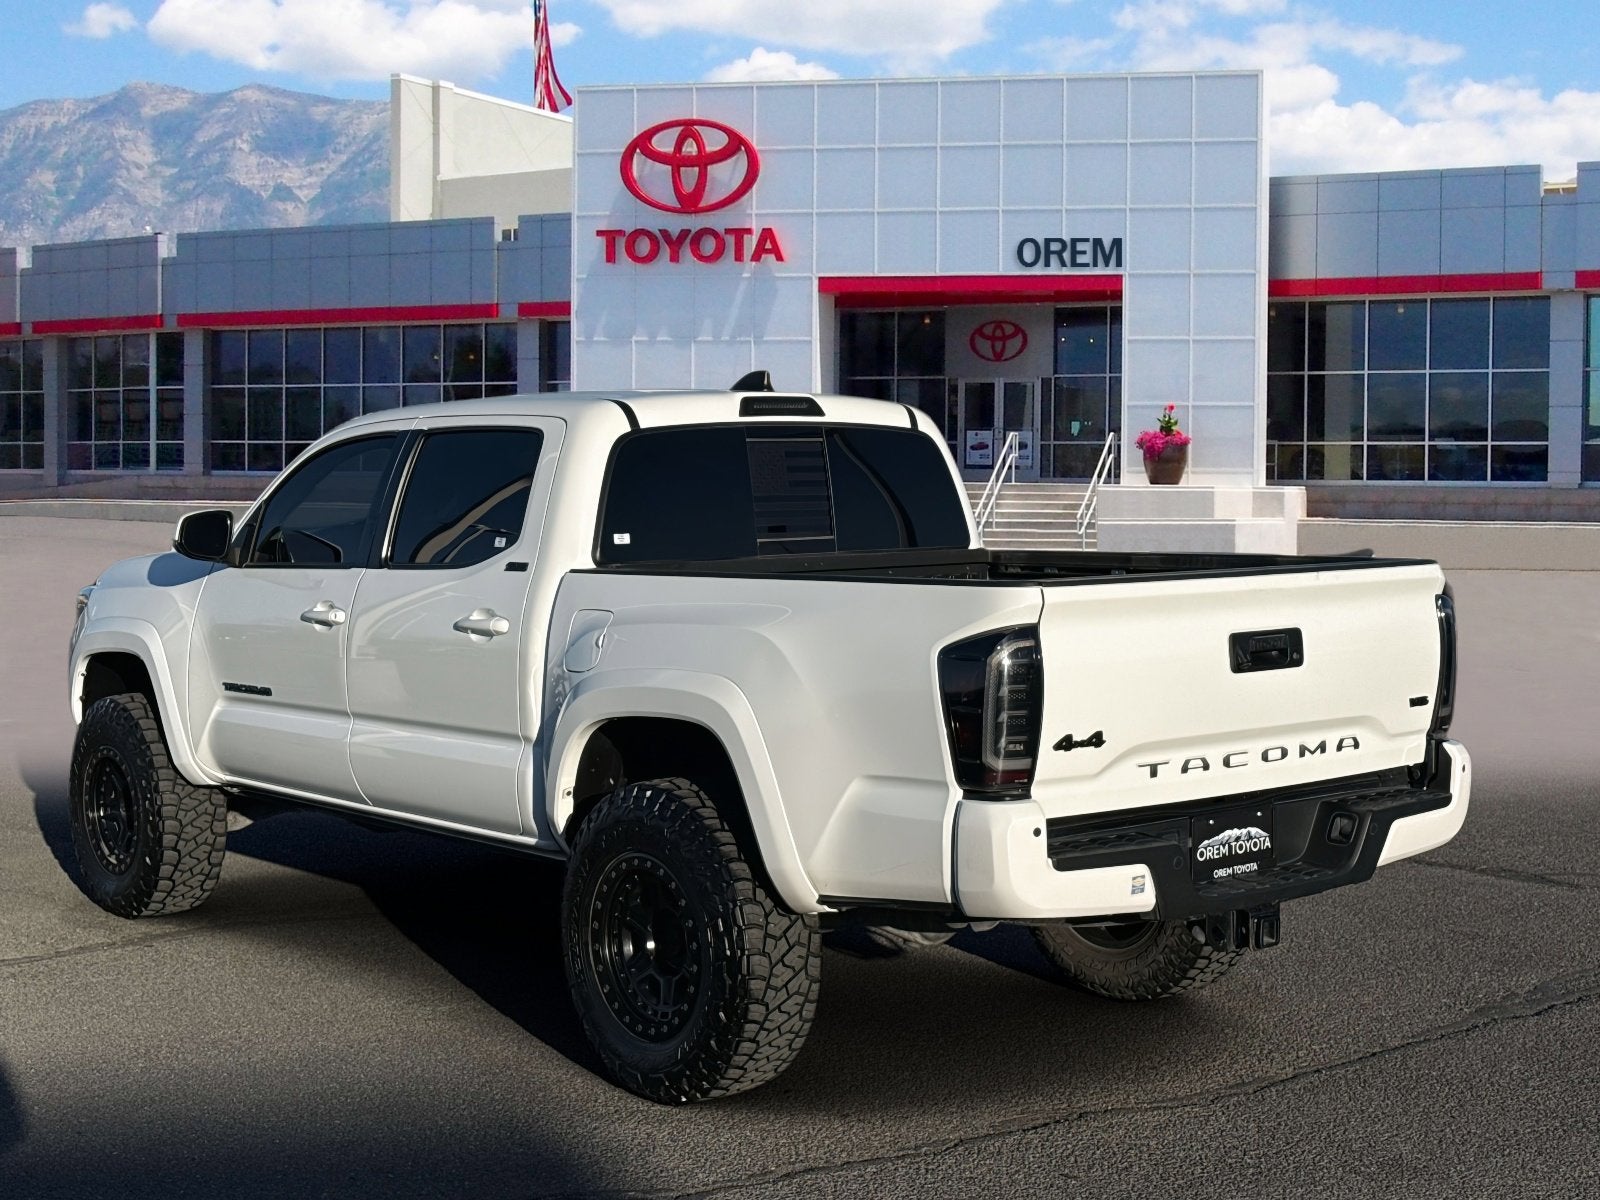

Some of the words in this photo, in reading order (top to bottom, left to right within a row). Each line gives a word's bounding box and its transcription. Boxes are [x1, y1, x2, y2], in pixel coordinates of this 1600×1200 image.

[596, 227, 785, 264] TOYOTA
[1016, 237, 1123, 268] OREM
[1137, 735, 1361, 779] TACOMA
[1196, 843, 1229, 862] OREM
[1230, 836, 1272, 855] TOYOTA
[1213, 866, 1233, 879] OREM
[1233, 862, 1258, 875] TOYOTA
